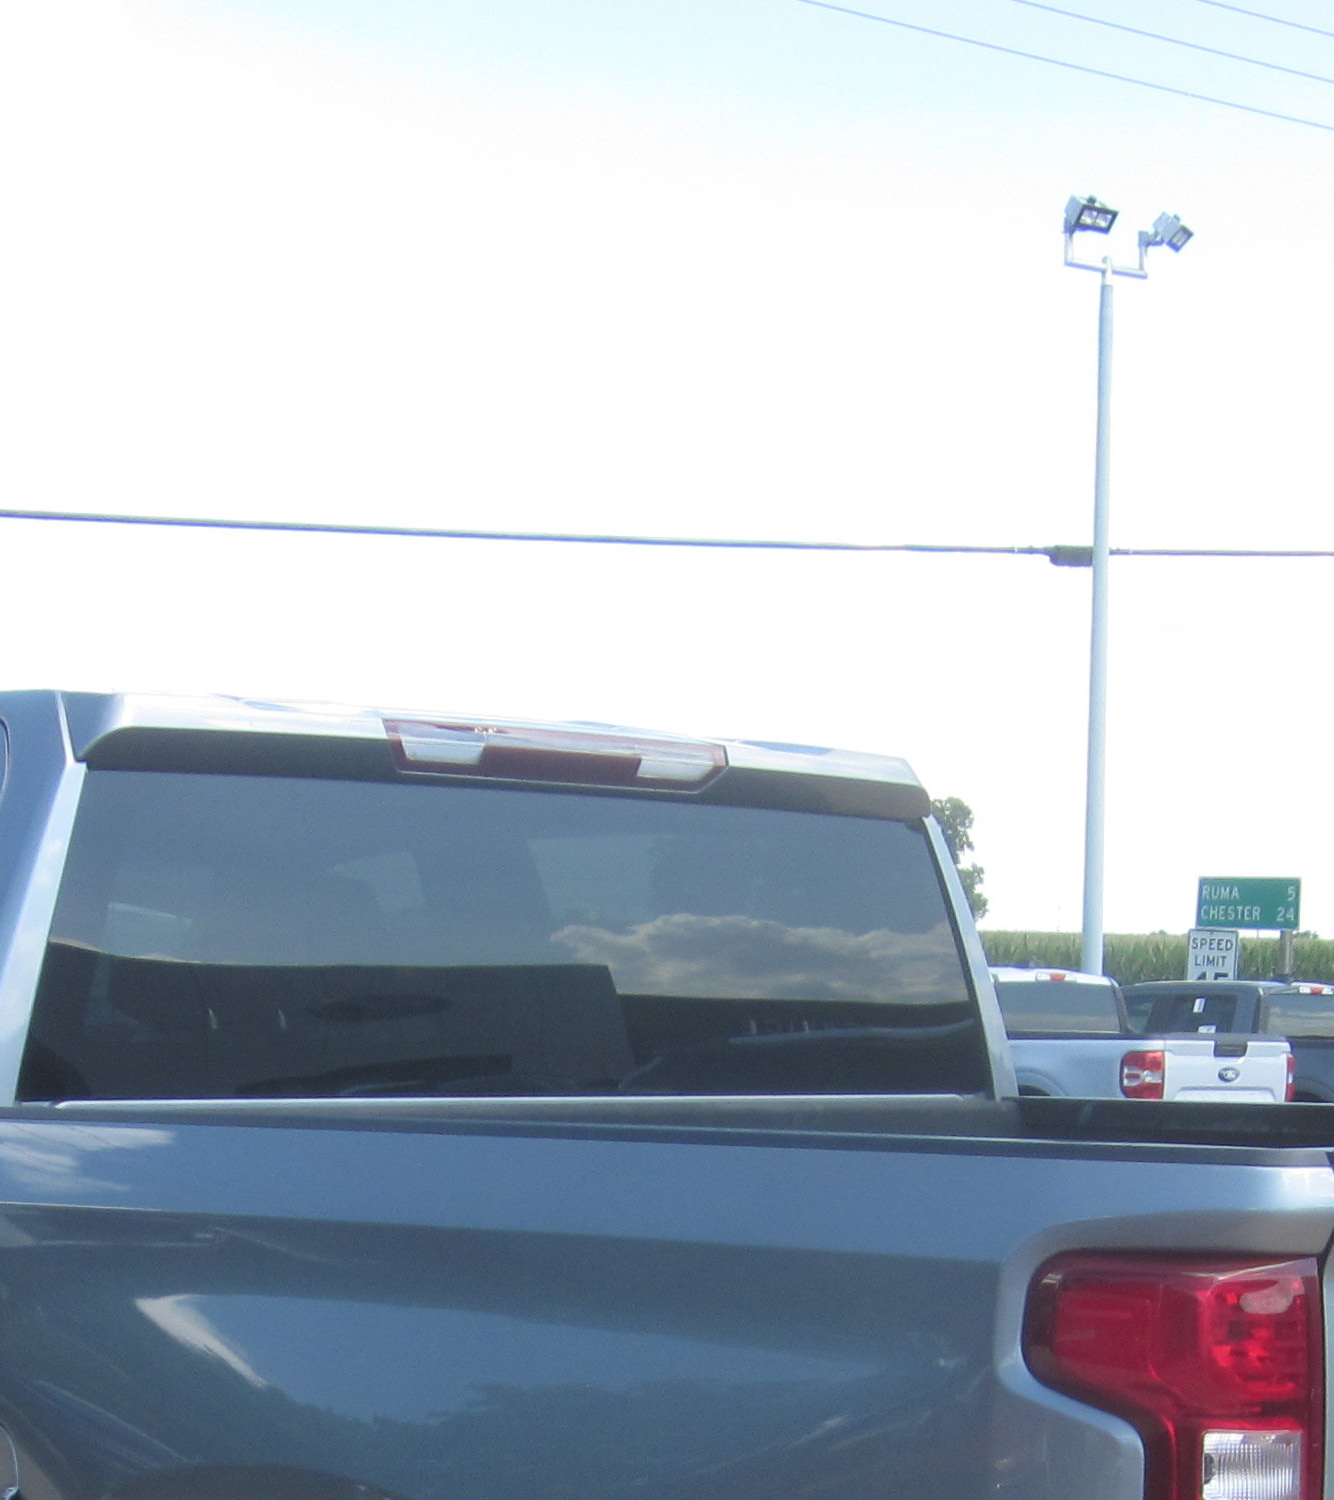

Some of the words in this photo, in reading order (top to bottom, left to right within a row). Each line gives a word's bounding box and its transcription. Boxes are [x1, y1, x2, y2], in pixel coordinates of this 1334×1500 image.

[1202, 885, 1240, 900] RUMA
[1287, 885, 1296, 901] 5
[1201, 904, 1261, 921] CHESTER
[1276, 906, 1295, 922] 24
[1191, 937, 1234, 951] SPEED
[1194, 954, 1228, 967] LIMIT
